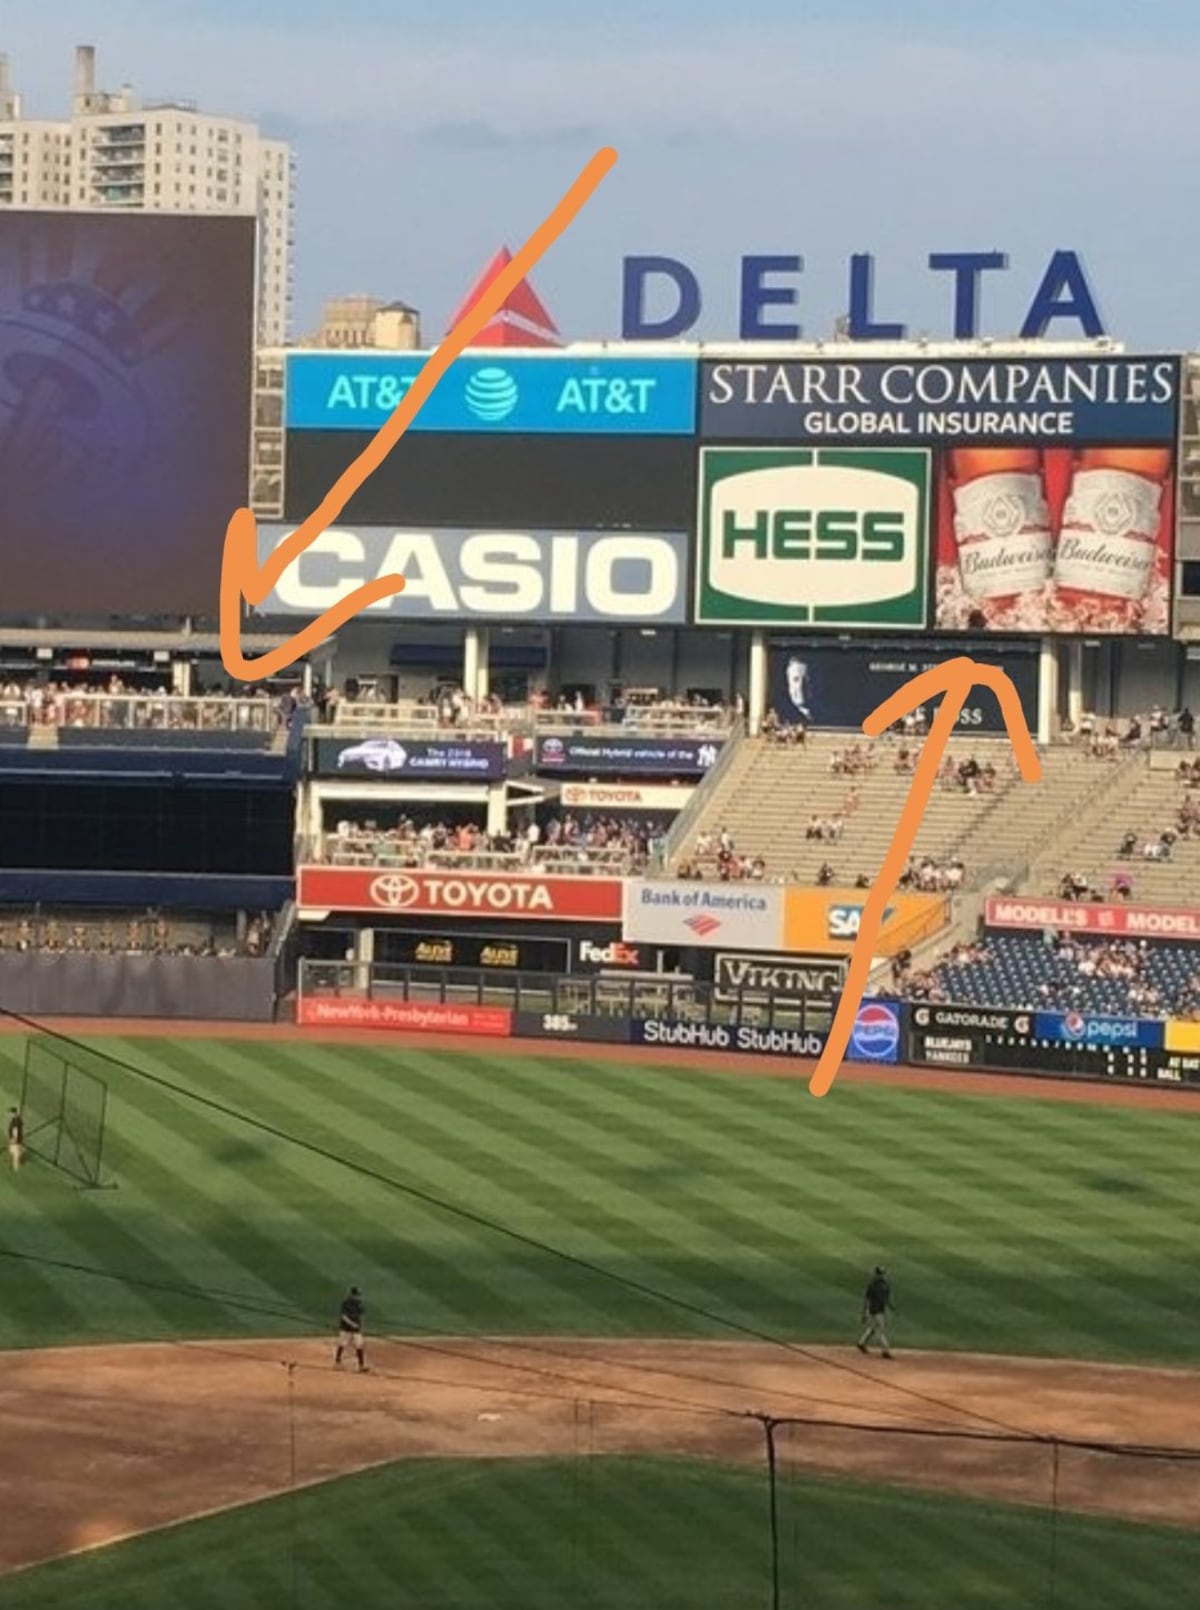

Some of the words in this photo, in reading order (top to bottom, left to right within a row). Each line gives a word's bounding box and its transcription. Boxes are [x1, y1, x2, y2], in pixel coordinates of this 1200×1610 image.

[622, 249, 1107, 340] DELTA
[327, 374, 416, 410] AT&
[556, 378, 656, 413] AT&T
[709, 364, 871, 404] STARR
[880, 362, 1174, 404] COMPANIES
[804, 412, 908, 434] GLOBAL
[917, 411, 1073, 434] INSURANCE
[722, 510, 905, 561] HESS
[274, 530, 678, 616] CASIO
[589, 789, 641, 802] TOYOTA
[424, 880, 554, 909] TOYOTA
[641, 888, 680, 905] Bank
[684, 889, 700, 906] of
[701, 890, 767, 911] America
[579, 940, 640, 966] FedEx
[643, 1020, 731, 1048] StubHub
[935, 1011, 1009, 1030] GATORADE
[1087, 1021, 1138, 1041] pepsi
[736, 1026, 823, 1055] StubHub
